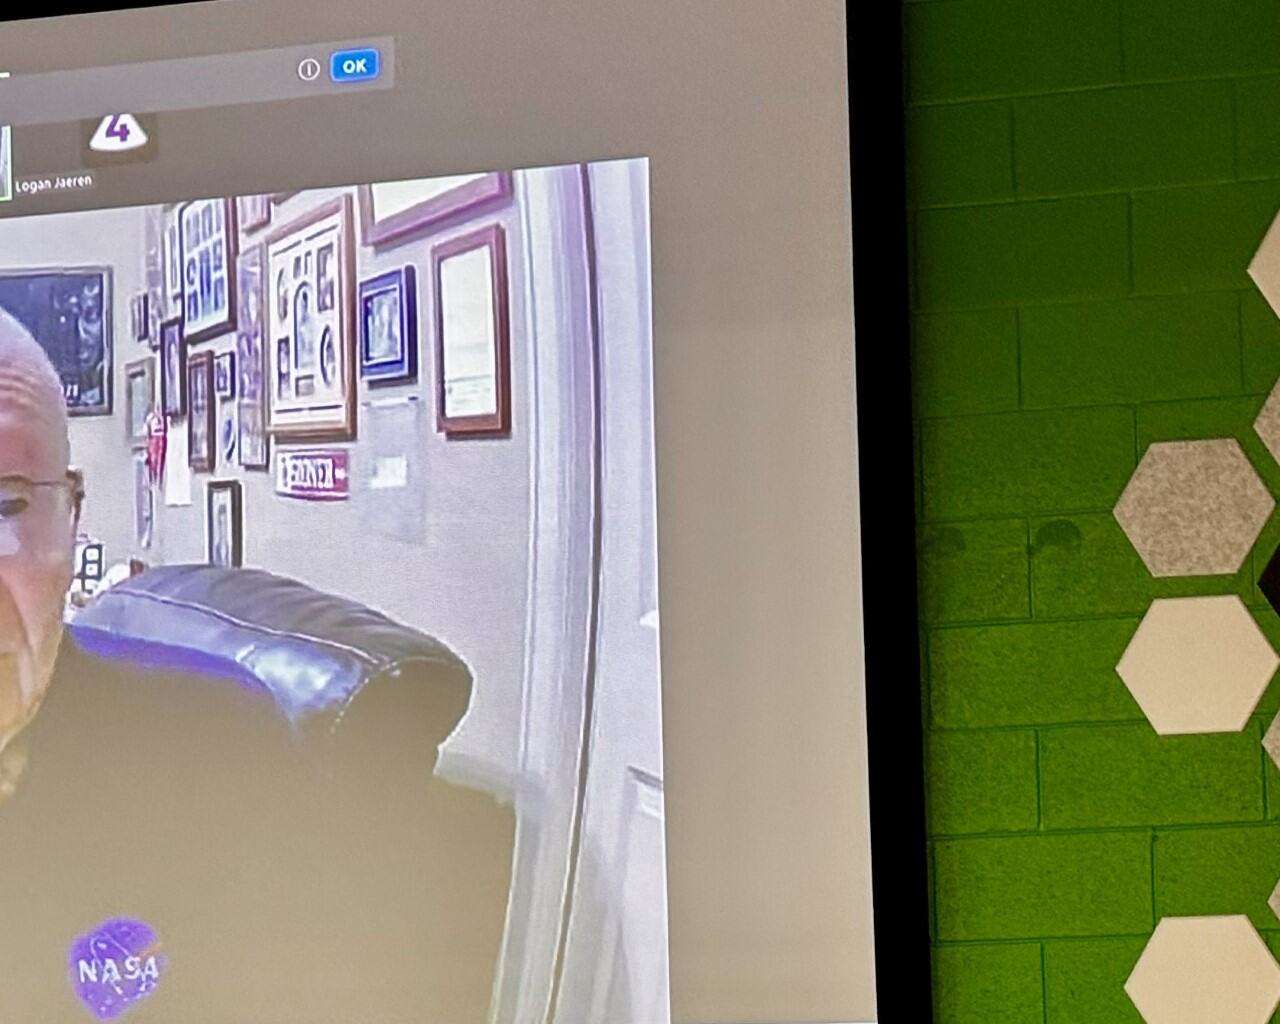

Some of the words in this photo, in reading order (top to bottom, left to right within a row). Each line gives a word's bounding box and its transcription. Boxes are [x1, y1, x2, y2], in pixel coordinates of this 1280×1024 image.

[343, 58, 367, 73] OK
[15, 178, 52, 194] Logan
[78, 955, 160, 986] NASA
